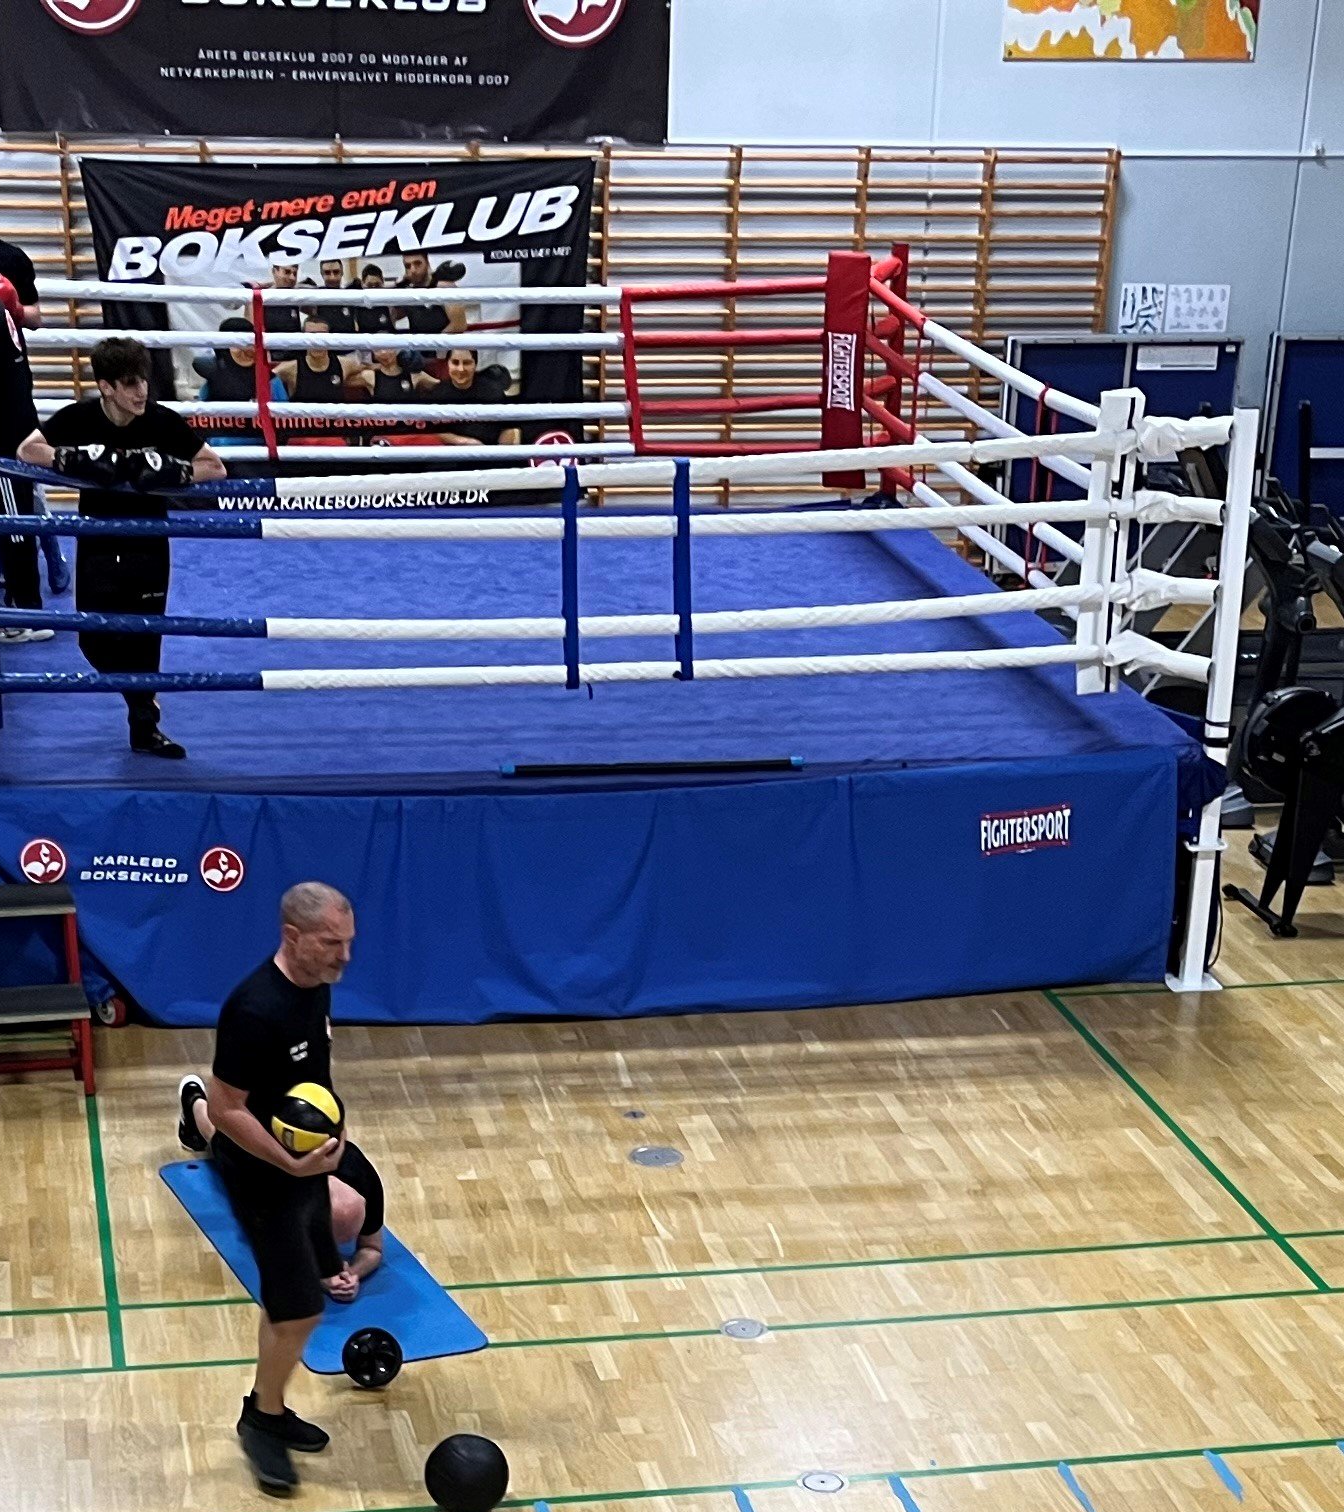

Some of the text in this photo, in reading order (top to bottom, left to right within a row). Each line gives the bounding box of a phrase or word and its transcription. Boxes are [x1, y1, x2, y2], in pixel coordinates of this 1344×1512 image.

[242, 50, 316, 63] BOKSEKLUB
[321, 52, 353, 64] 2007
[359, 53, 376, 65] OG
[382, 54, 448, 66] MODTAGER
[454, 56, 468, 67] AF
[478, 74, 509, 86] 2007
[165, 180, 437, 232] Meget mere end en
[107, 184, 581, 282] BOKSEKLUB
[832, 332, 852, 410] FIGHTERSPORT
[980, 808, 1071, 852] FIGHTERSPORT
[79, 870, 189, 884] BOKSEKLUB
[93, 855, 178, 869] KARLEBO
